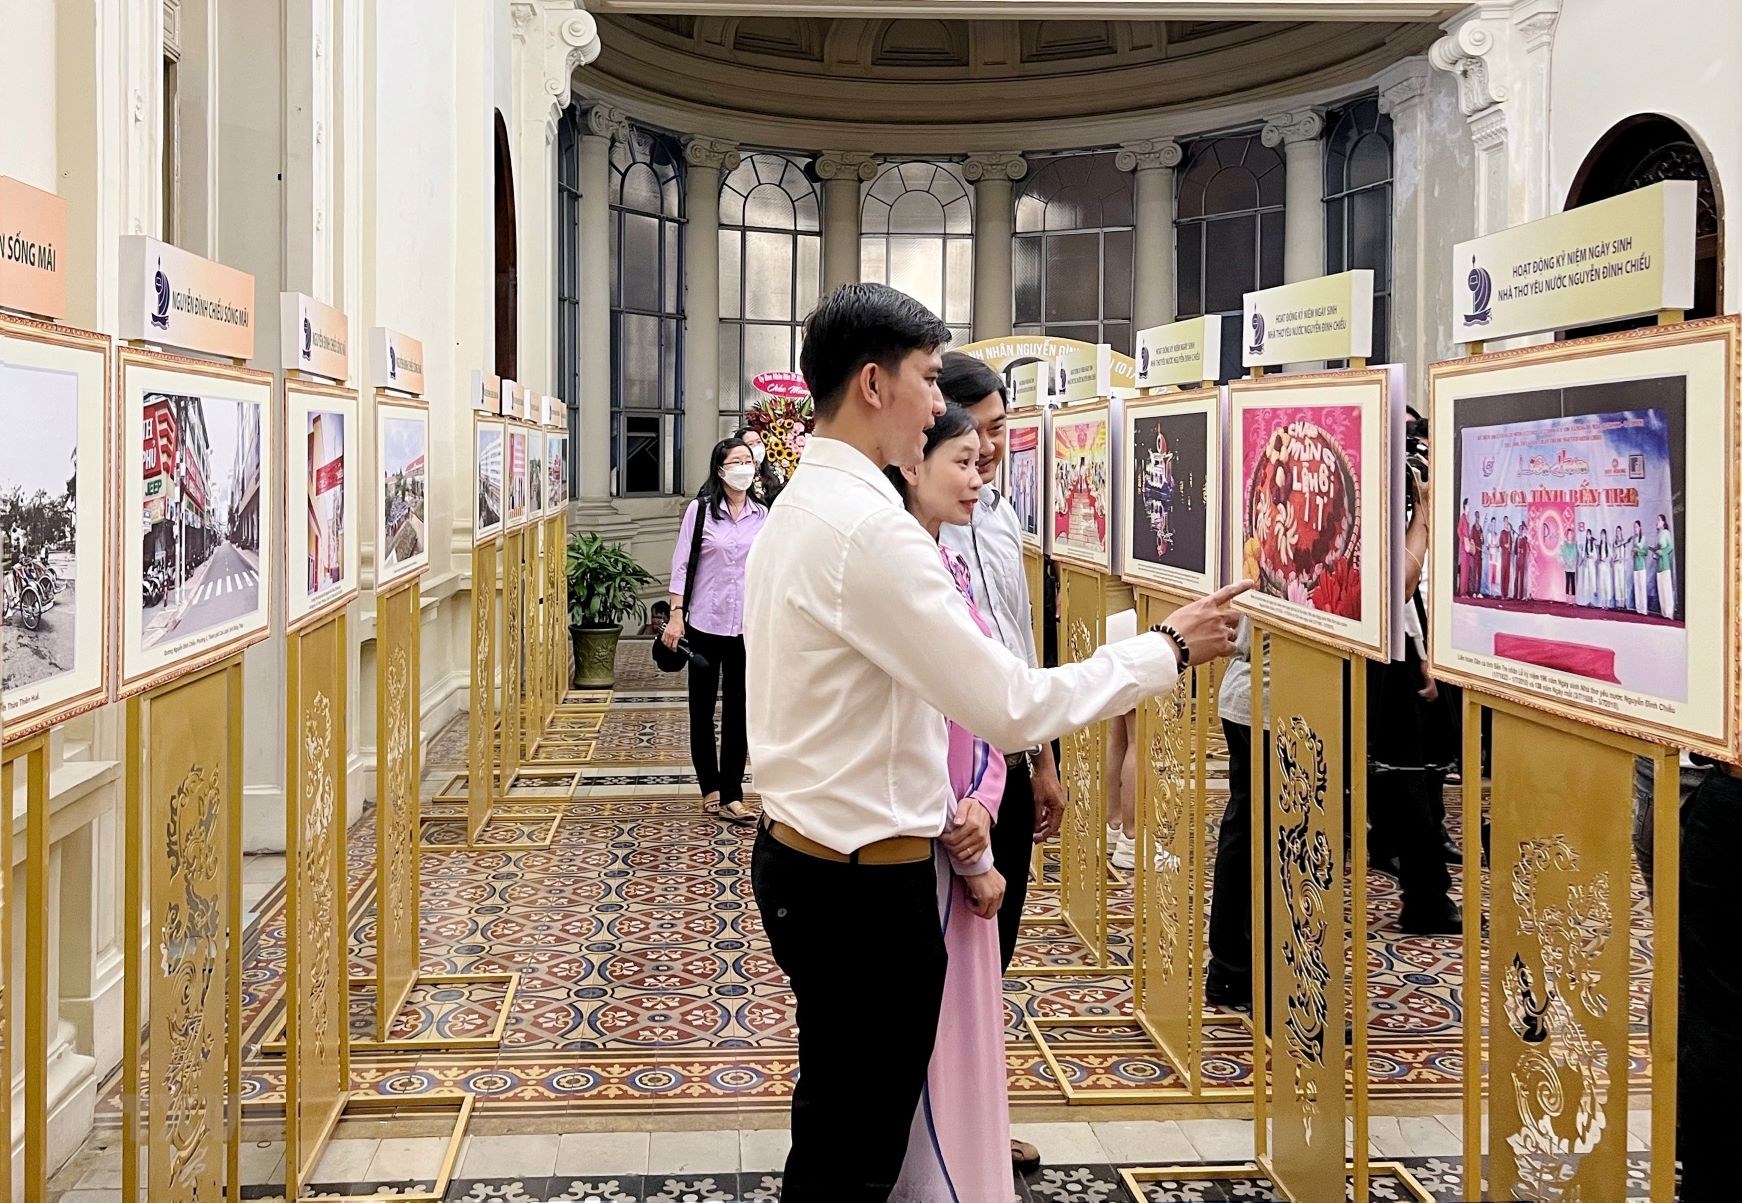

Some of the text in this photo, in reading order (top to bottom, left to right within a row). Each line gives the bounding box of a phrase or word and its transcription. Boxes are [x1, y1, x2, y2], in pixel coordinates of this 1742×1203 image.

[8, 230, 35, 266] SỐNG
[1513, 262, 1531, 279] HOẠT
[1533, 256, 1554, 275] ĐỘNG
[1567, 247, 1587, 267] NIỆM
[1588, 241, 1610, 260] NGÀY
[1612, 236, 1632, 254] SINH
[1498, 285, 1513, 302] NHÀ
[1514, 284, 1529, 298] THƠ
[1530, 280, 1543, 295] YÊU
[1545, 274, 1567, 292] NƯỚC
[1568, 264, 1600, 287] NGUYỄN
[1602, 262, 1623, 279] ĐÌNH
[985, 343, 1014, 360] NHÂN
[1016, 340, 1056, 357] NGUYỄN
[145, 479, 162, 496] JEEP
[1603, 488, 1639, 508] TRE
